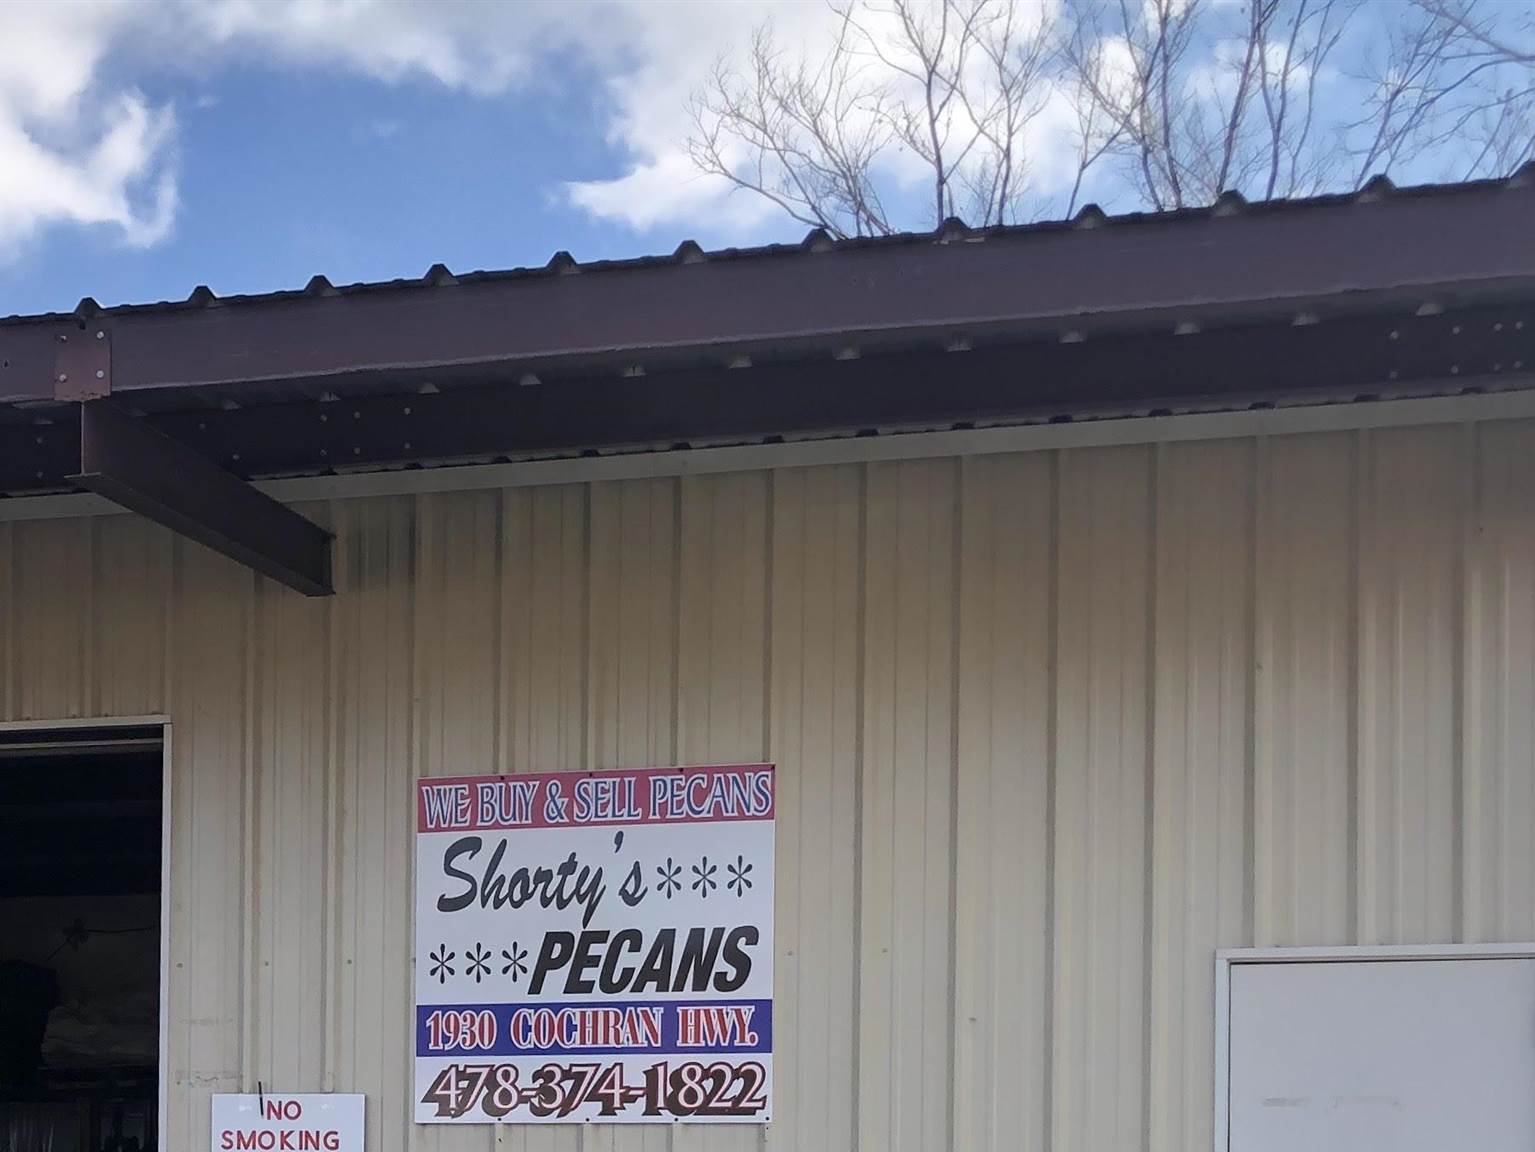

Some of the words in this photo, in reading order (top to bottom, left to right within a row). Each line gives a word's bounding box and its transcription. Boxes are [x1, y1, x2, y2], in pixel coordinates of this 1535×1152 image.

[421, 785, 471, 828] WE
[476, 780, 537, 826] BUY
[543, 779, 569, 822] &
[573, 777, 641, 821] SELL
[649, 770, 772, 818] PECANS
[437, 831, 649, 928] Shorty's
[527, 925, 760, 995] PECANS
[426, 1010, 497, 1051] 1930
[510, 1006, 663, 1049] COCHRAN
[676, 1005, 759, 1047] HWY.
[266, 1100, 302, 1120] NO
[421, 1061, 768, 1118] 478-374-1822
[220, 1130, 340, 1151] SMOKING
